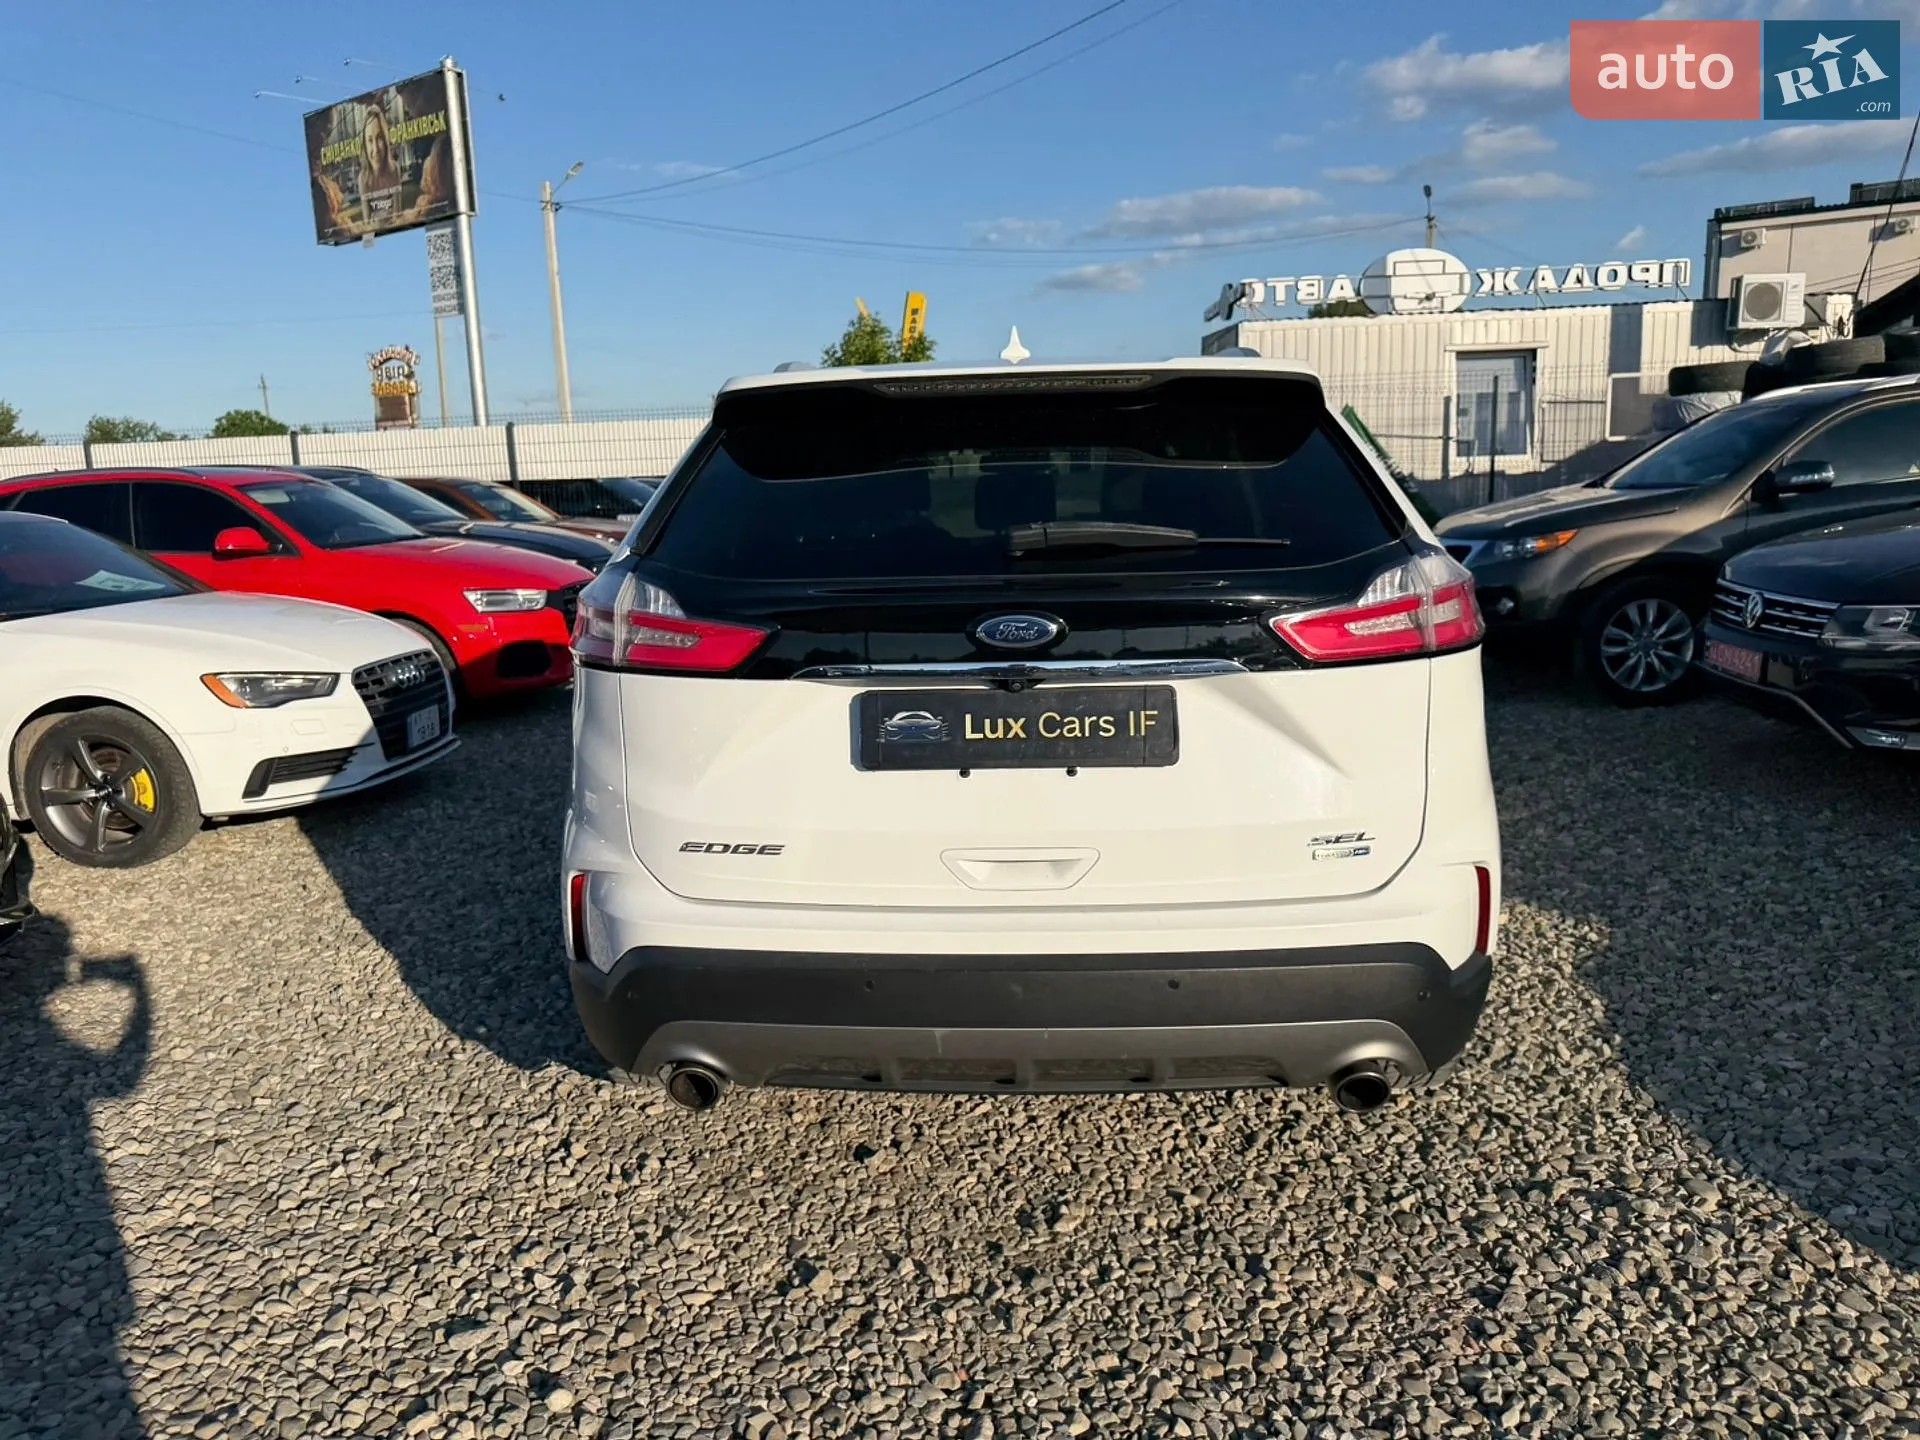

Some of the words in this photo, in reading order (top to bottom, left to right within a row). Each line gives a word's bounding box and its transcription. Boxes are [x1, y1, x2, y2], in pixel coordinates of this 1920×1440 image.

[996, 622, 1038, 641] Ford
[964, 712, 1028, 740] Lux
[1038, 711, 1116, 738] Cars
[1128, 709, 1158, 737] IF
[1307, 831, 1376, 846] SEL
[678, 841, 786, 856] EDGE
